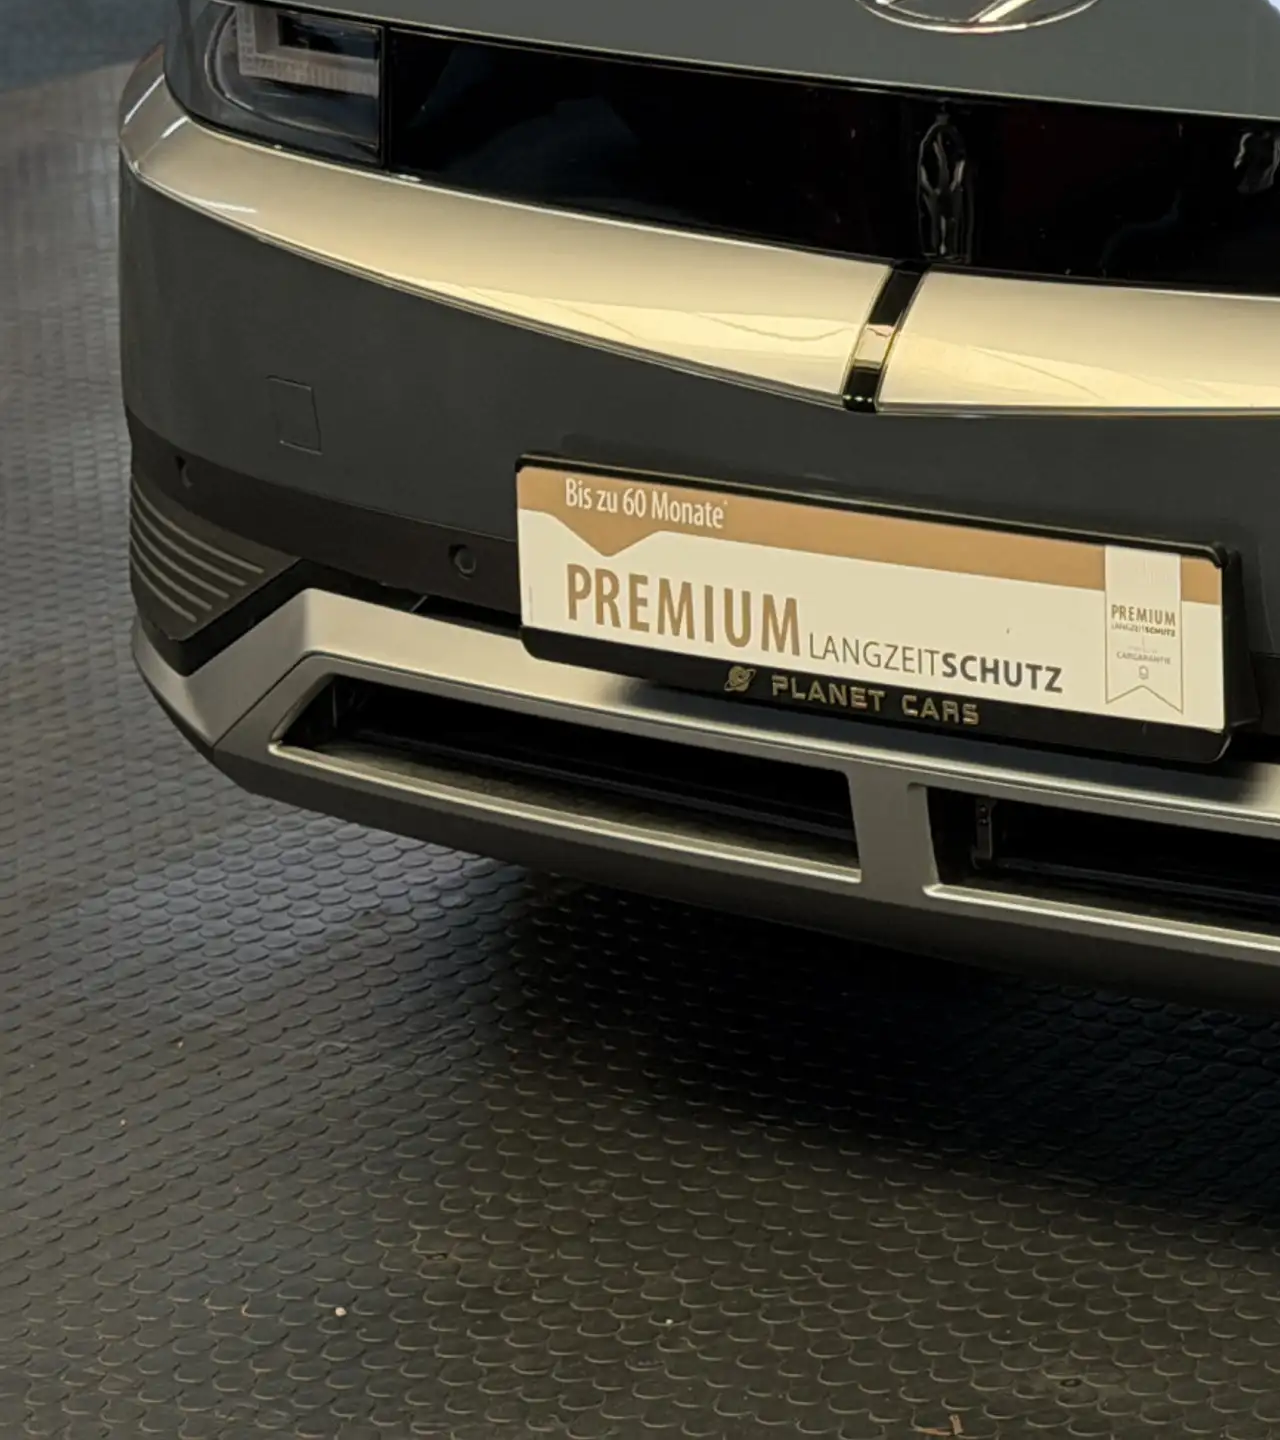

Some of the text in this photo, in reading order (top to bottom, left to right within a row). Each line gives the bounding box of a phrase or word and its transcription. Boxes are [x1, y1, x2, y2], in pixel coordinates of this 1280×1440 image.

[565, 478, 592, 510] Bis
[596, 490, 618, 513] zu
[623, 488, 646, 518] 60
[567, 563, 1063, 693] PREMIUM LANGZEITSCHUTZ
[1111, 604, 1176, 626] PREMIUM
[771, 674, 980, 726] PLANET CARS
